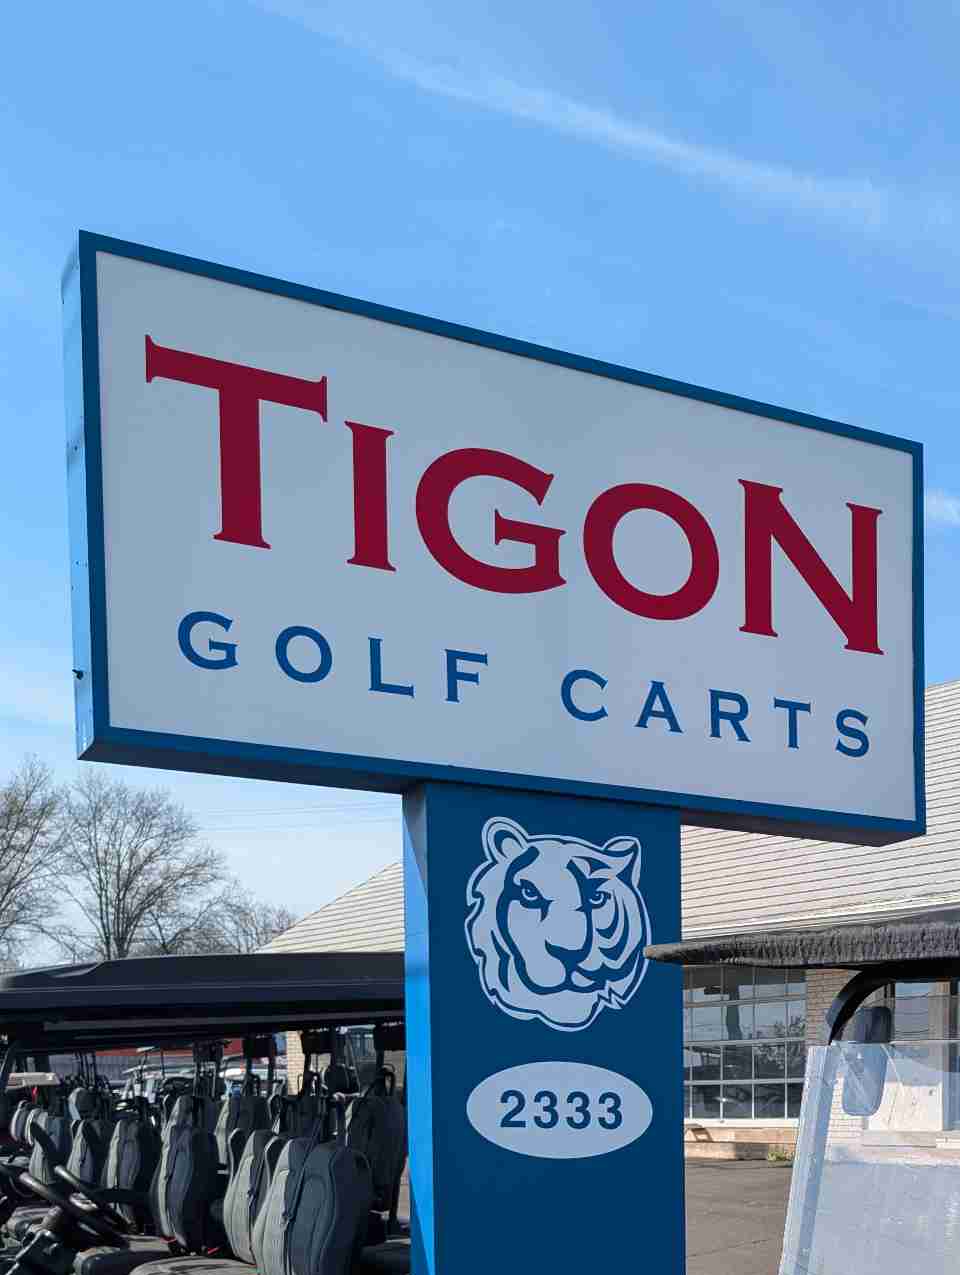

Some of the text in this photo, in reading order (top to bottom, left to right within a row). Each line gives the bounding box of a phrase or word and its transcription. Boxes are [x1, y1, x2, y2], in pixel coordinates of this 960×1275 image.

[145, 335, 883, 656] TIGON
[178, 610, 870, 758] GOLF CARTS
[499, 1090, 623, 1130] 2333
